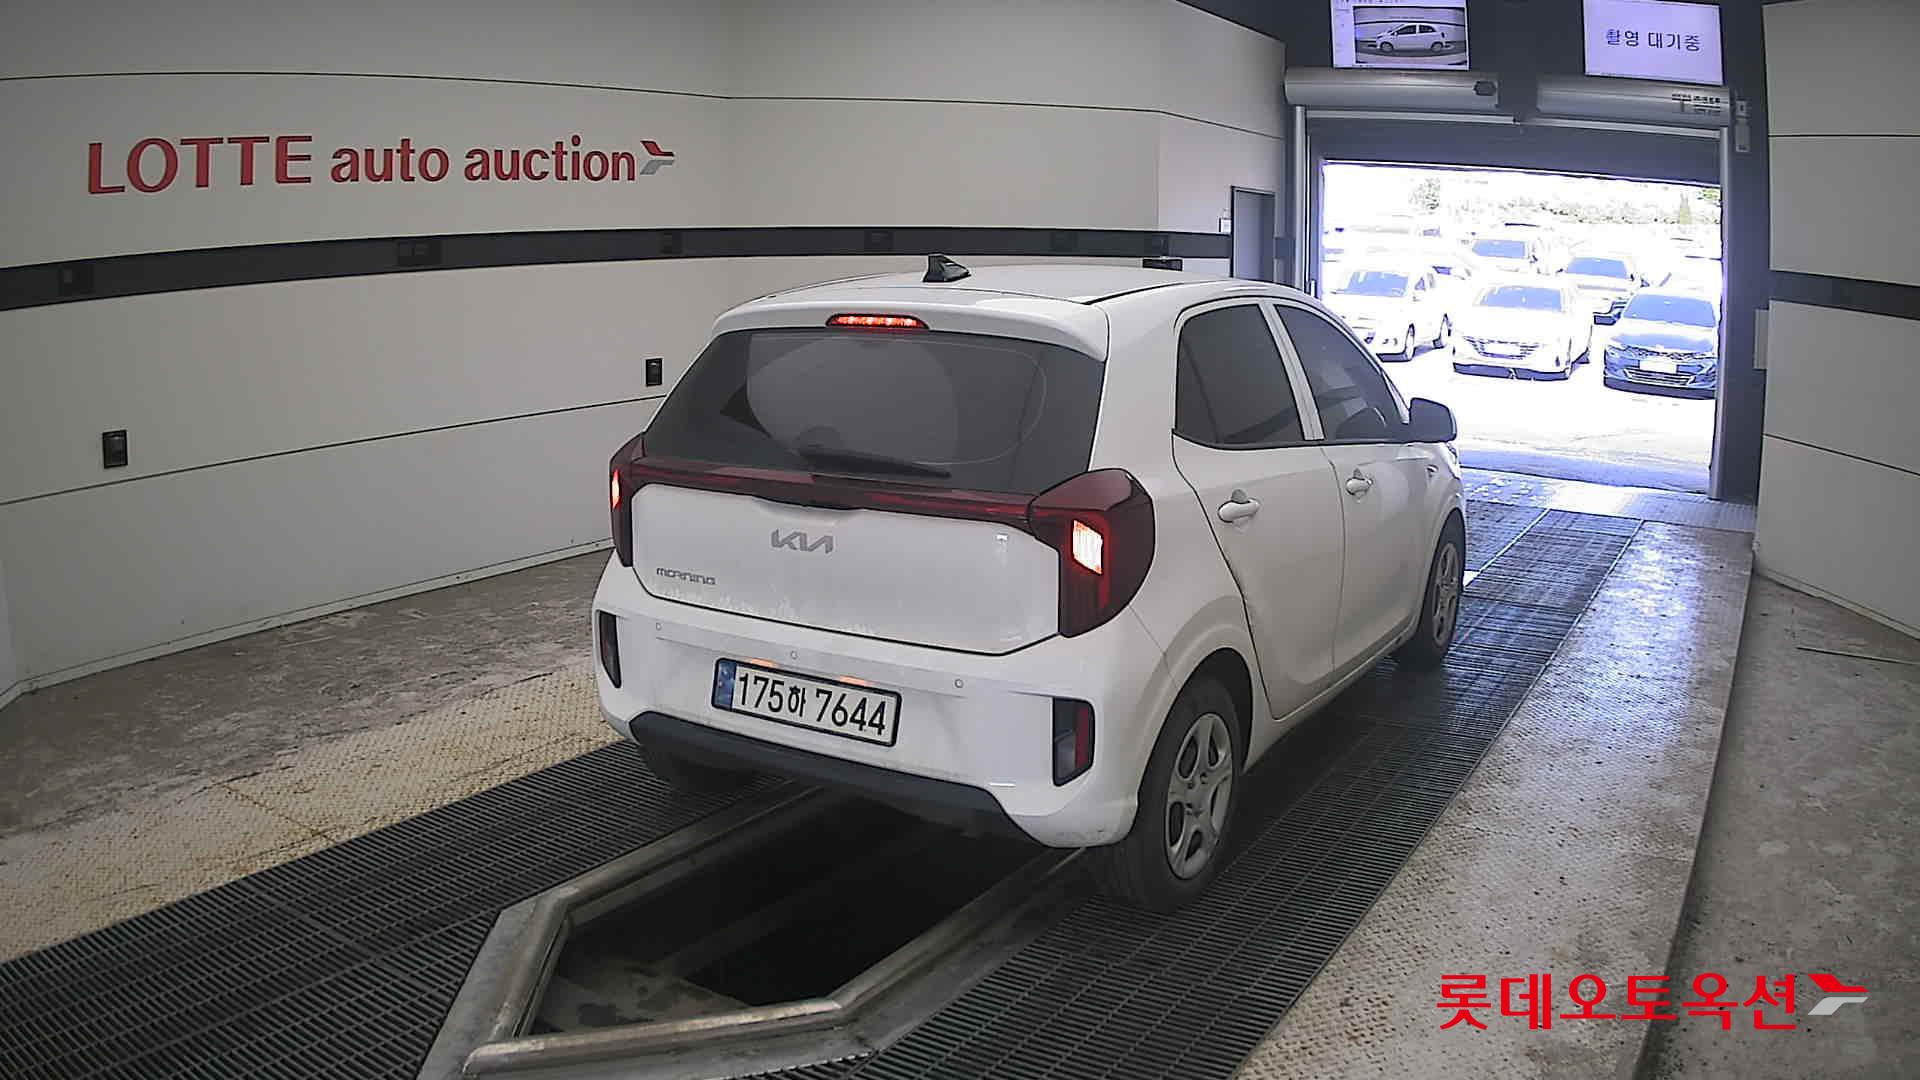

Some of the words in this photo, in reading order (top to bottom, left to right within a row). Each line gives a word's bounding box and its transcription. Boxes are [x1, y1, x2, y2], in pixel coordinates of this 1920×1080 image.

[1607, 29, 1639, 47] 촬영
[1648, 32, 1700, 52] 대기중
[88, 136, 313, 194] LOTTE
[330, 138, 449, 183] auto
[464, 135, 636, 183] auction
[771, 529, 834, 554] KIA
[738, 672, 806, 717] 175하
[815, 688, 887, 736] 7644
